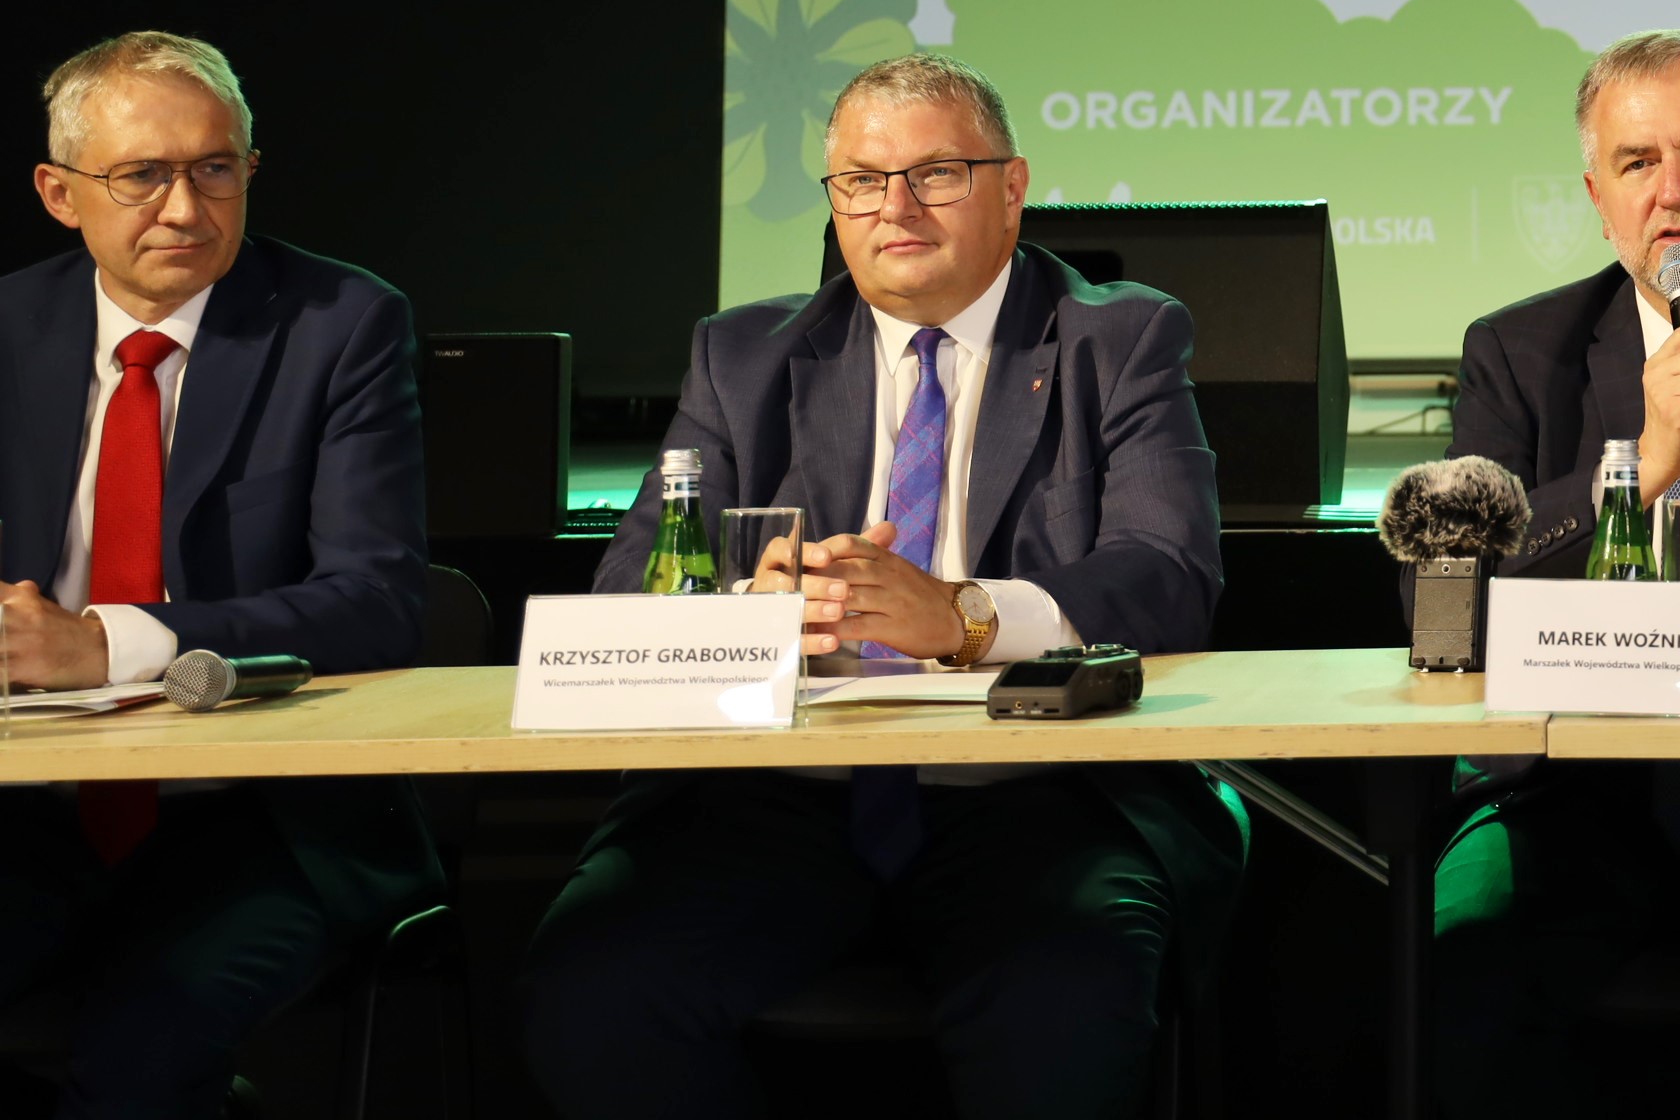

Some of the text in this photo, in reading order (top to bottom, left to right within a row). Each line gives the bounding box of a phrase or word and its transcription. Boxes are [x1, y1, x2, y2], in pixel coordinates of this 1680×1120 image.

[1040, 85, 1514, 132] ORGANIZATORZY
[1537, 630, 1608, 647] MAREK
[539, 646, 779, 667] KRZYSZTOF GRABOWSKI
[1522, 658, 1572, 668] Marszałek
[1573, 659, 1641, 671] Województwa
[543, 677, 616, 688] Wicemarszałek
[617, 676, 687, 688] Województwa
